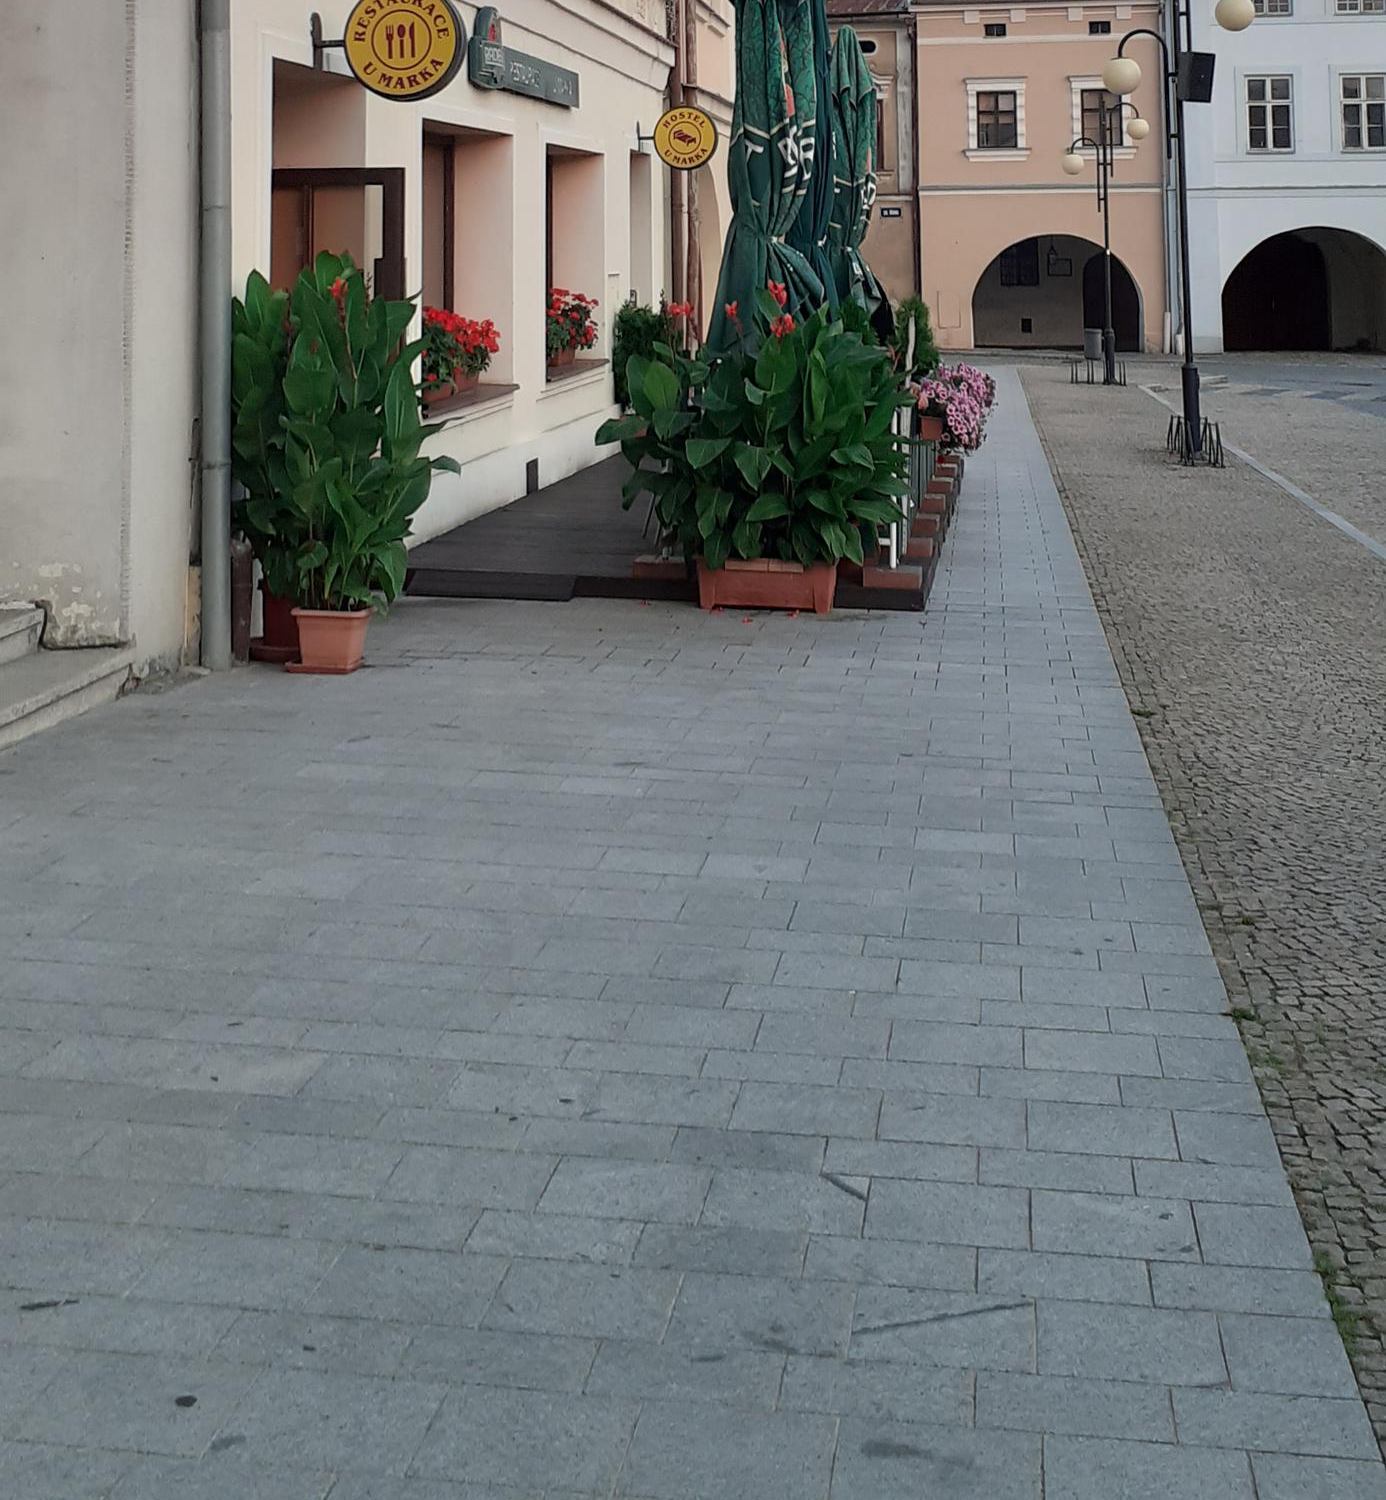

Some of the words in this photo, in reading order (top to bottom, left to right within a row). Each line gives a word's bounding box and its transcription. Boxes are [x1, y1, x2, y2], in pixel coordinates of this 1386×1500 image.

[363, 61, 378, 76] U
[377, 58, 445, 89] MARKA
[663, 111, 706, 129] HOSTEL
[663, 149, 673, 158] U
[672, 147, 708, 165] MARKA
